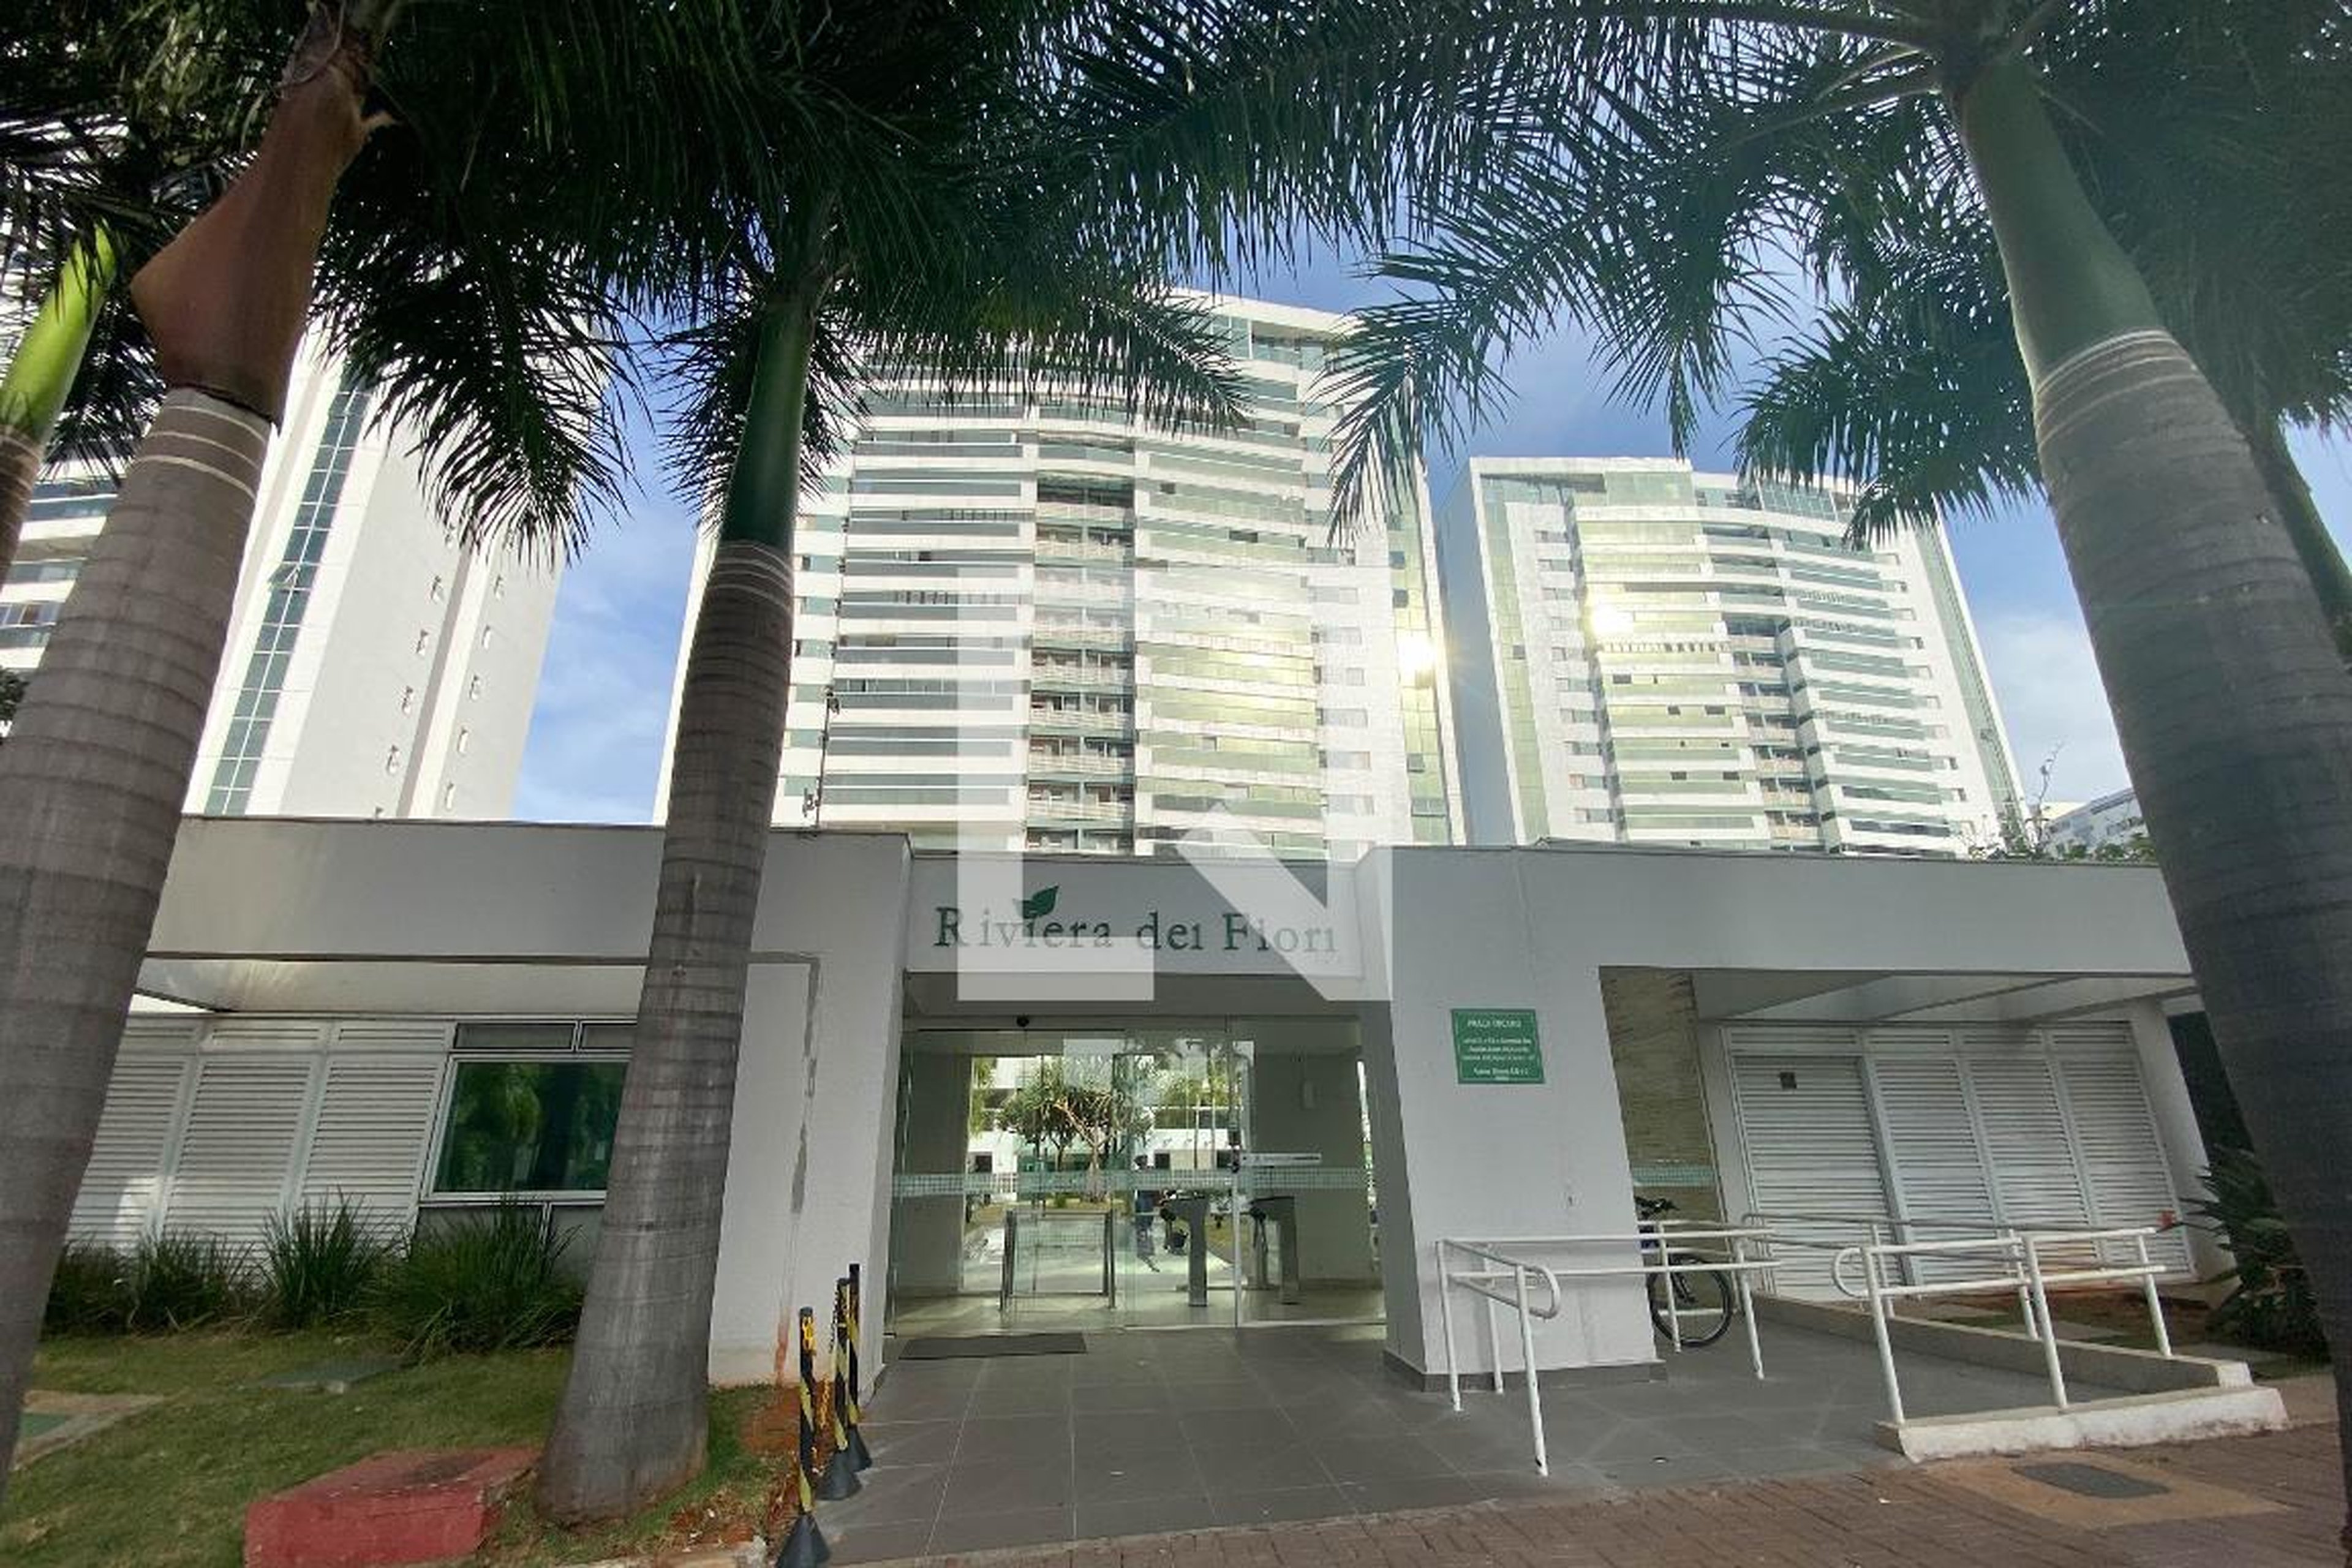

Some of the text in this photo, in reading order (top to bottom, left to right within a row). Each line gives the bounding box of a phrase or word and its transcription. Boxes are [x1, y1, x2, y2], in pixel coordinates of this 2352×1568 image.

[933, 907, 1337, 952] Riviera dei Fiori
